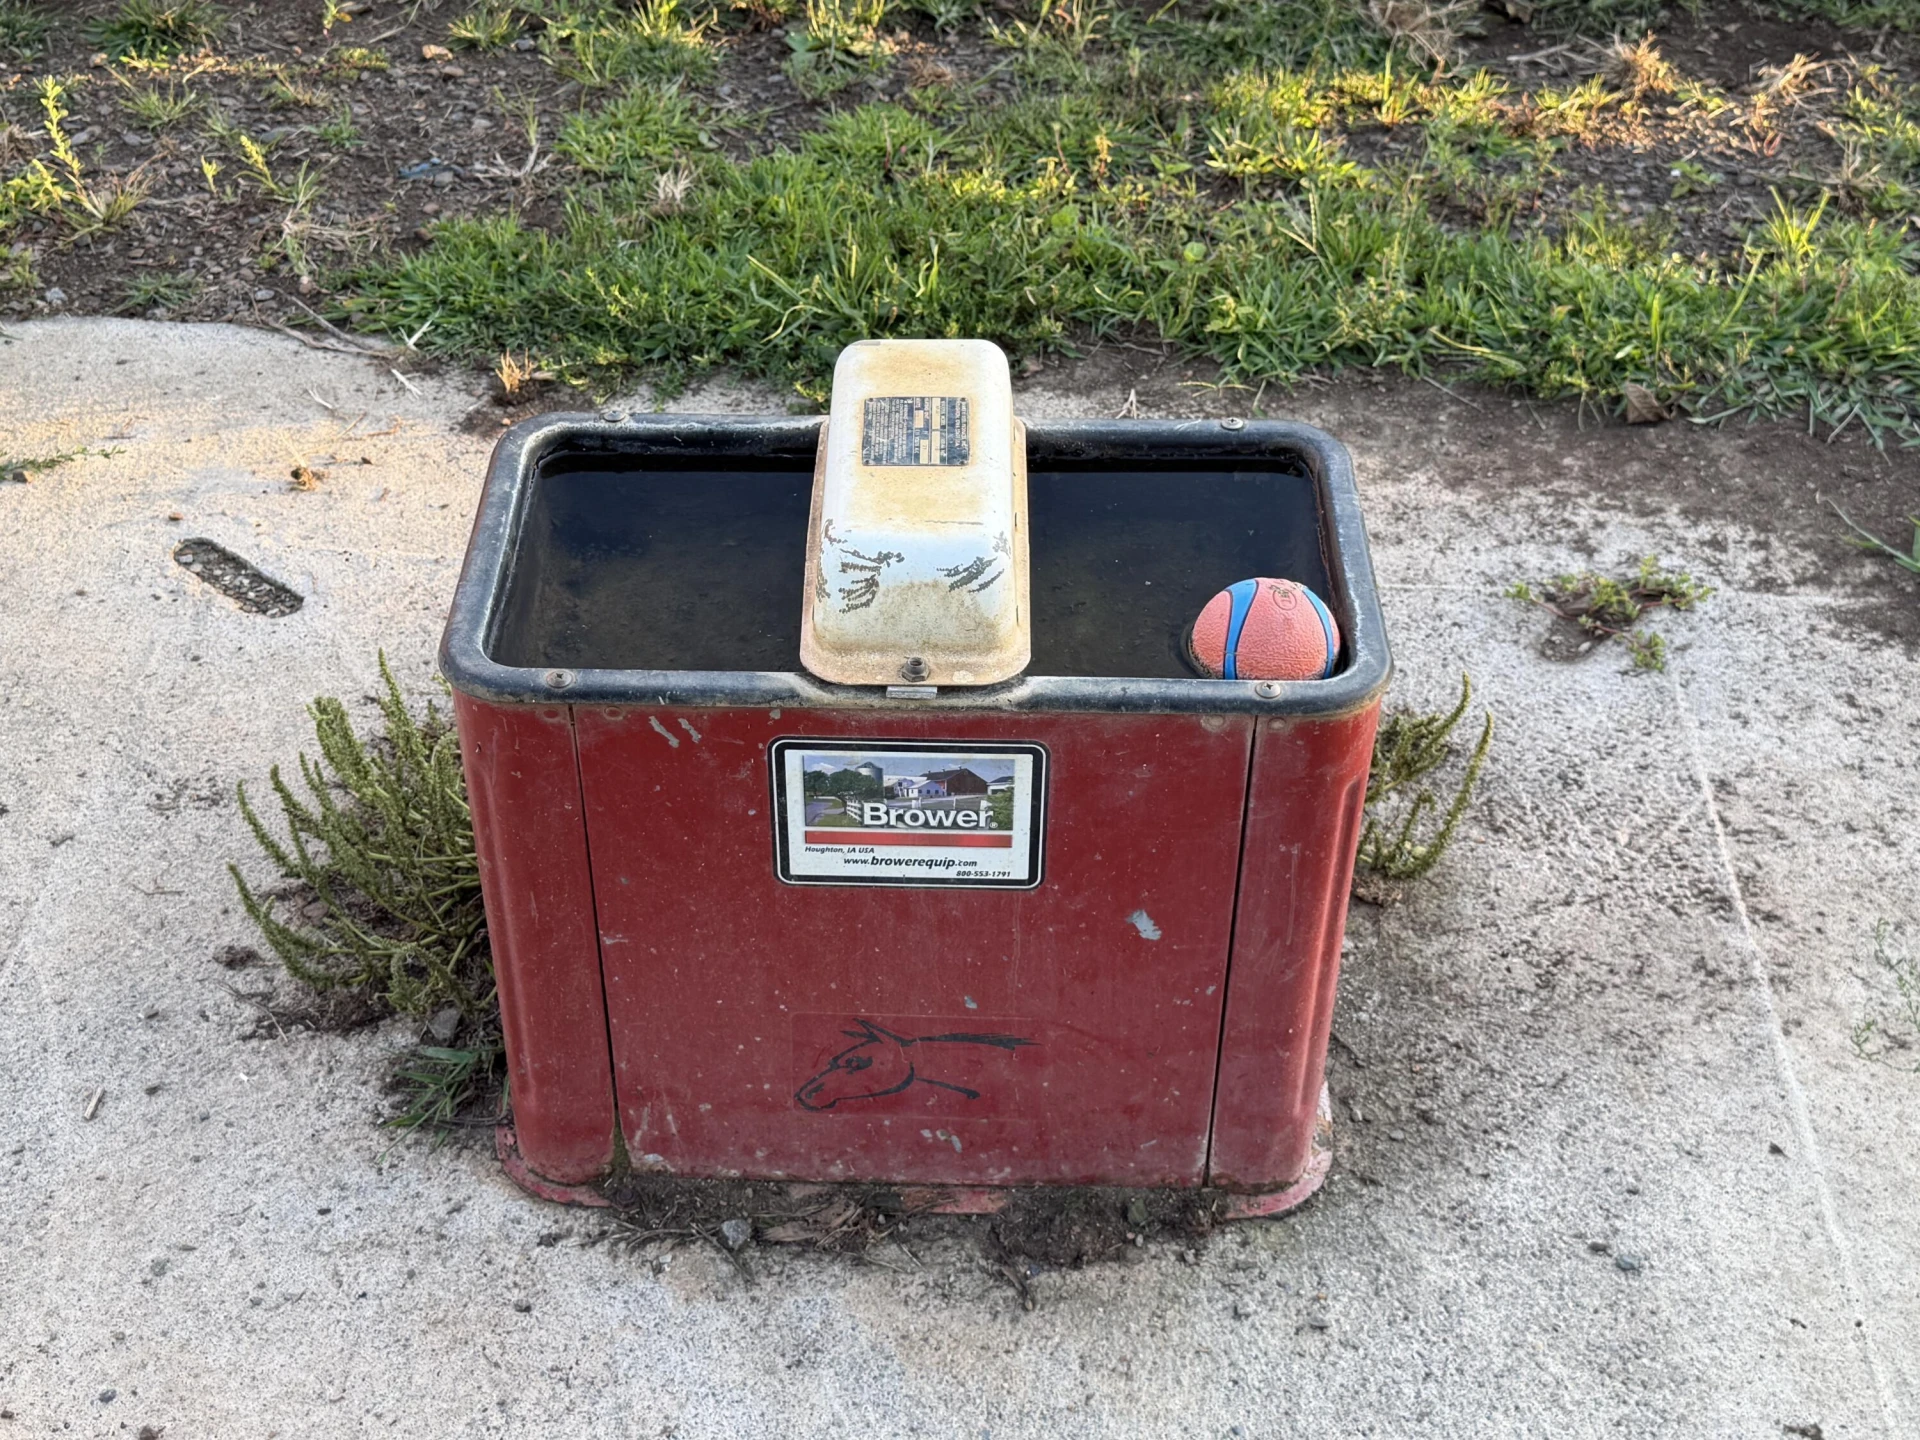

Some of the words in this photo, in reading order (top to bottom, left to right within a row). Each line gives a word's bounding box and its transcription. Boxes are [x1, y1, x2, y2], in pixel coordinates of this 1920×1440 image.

[805, 846, 845, 855] Houghton,
[843, 856, 978, 869] www.browerequip.com
[956, 870, 1011, 878] 800-553-1791
